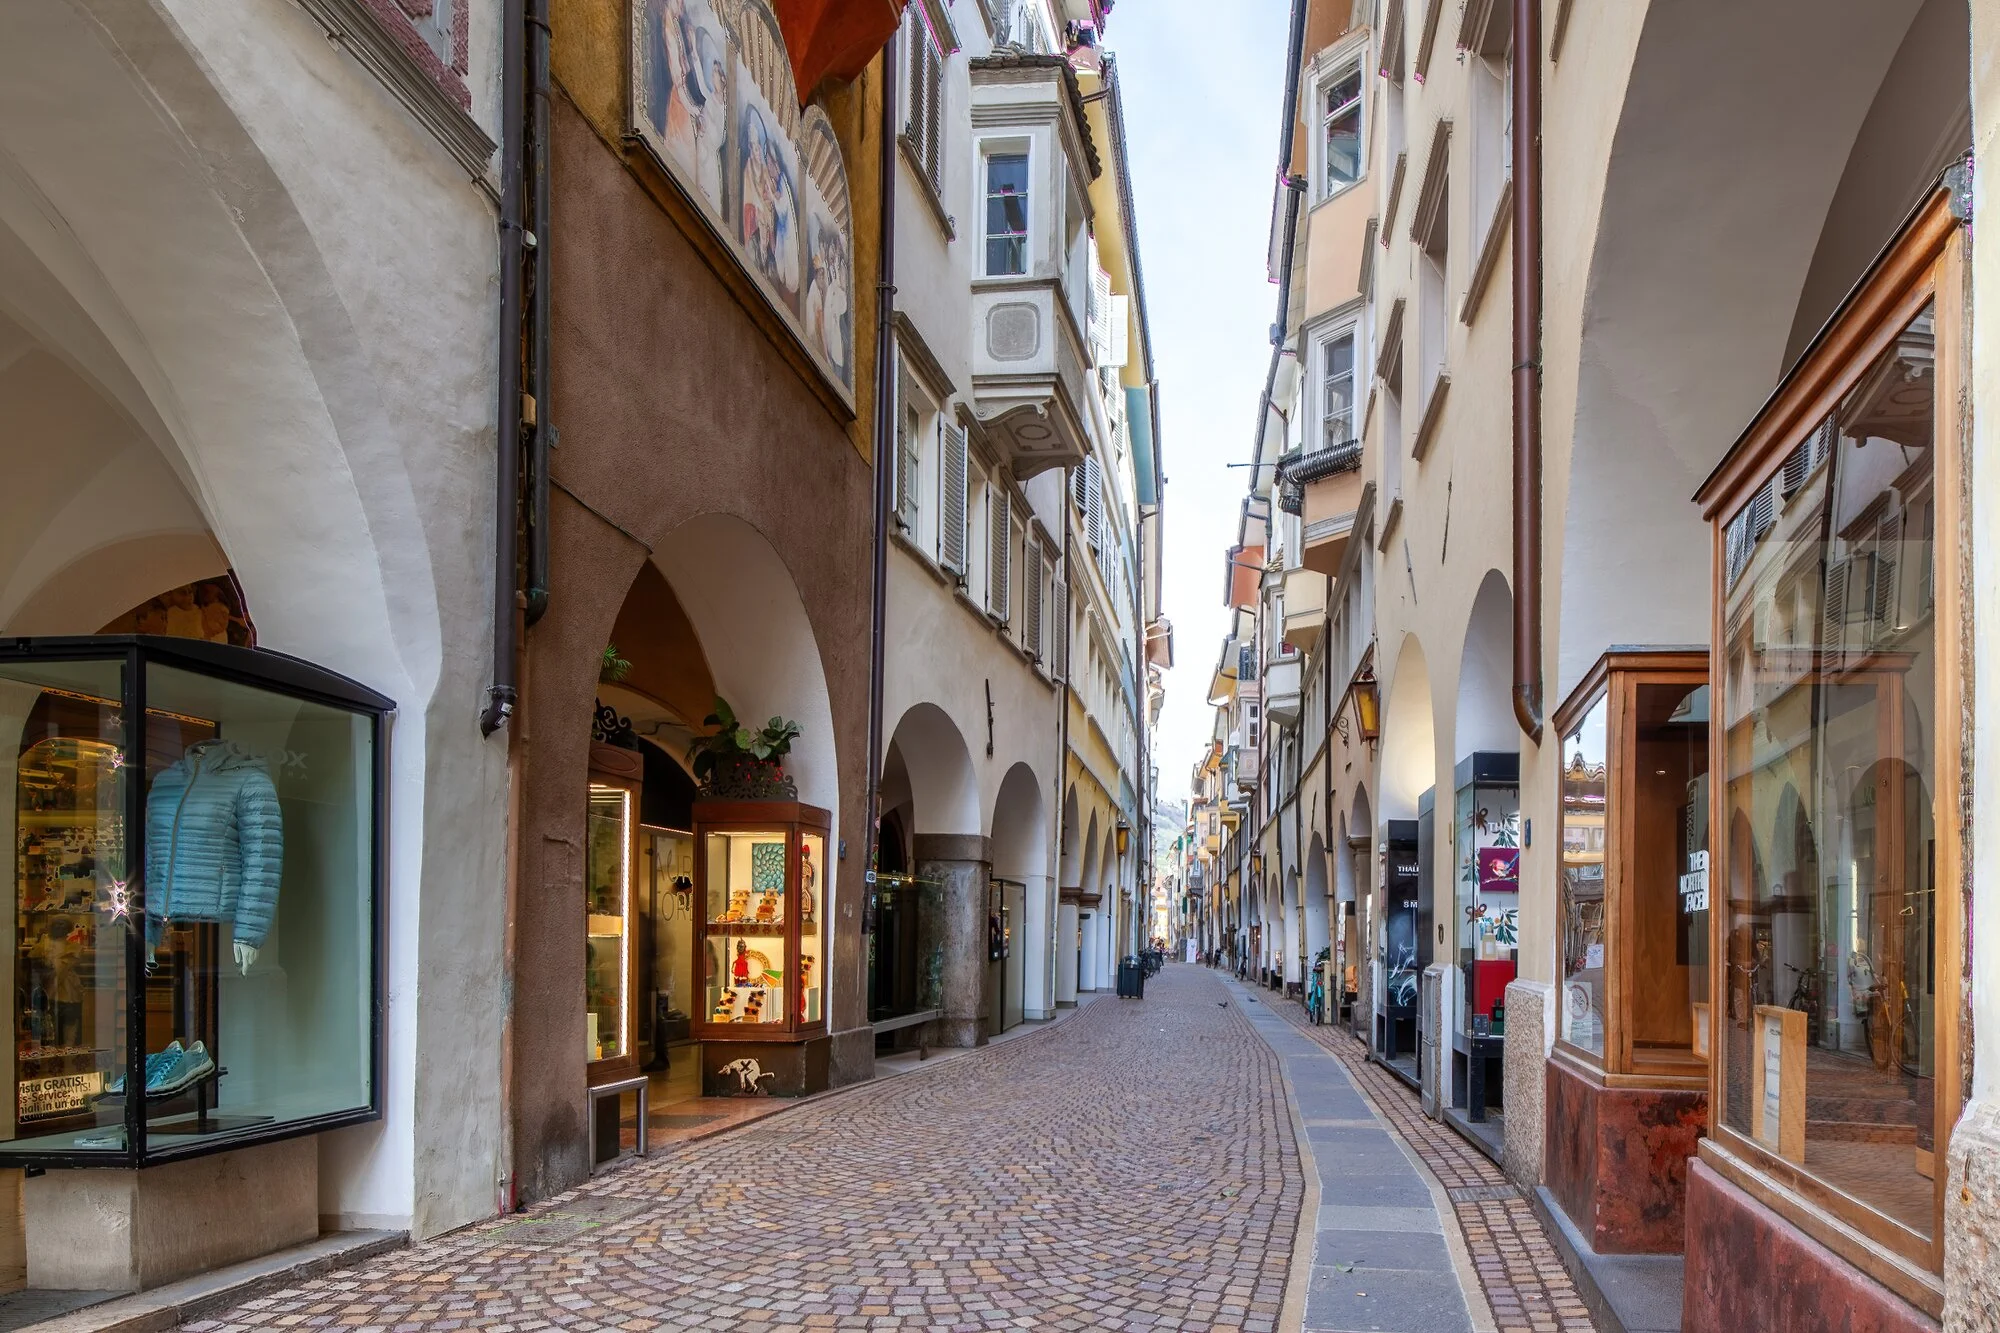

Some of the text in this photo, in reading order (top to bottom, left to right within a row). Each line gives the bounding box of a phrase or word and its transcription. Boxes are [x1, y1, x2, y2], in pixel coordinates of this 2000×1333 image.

[1690, 850, 1709, 871] THE
[1680, 871, 1707, 894] NORTH
[1686, 891, 1709, 911] FACE
[44, 1076, 84, 1091] GRATIS!
[43, 1101, 52, 1111] in
[55, 1100, 67, 1109] un
